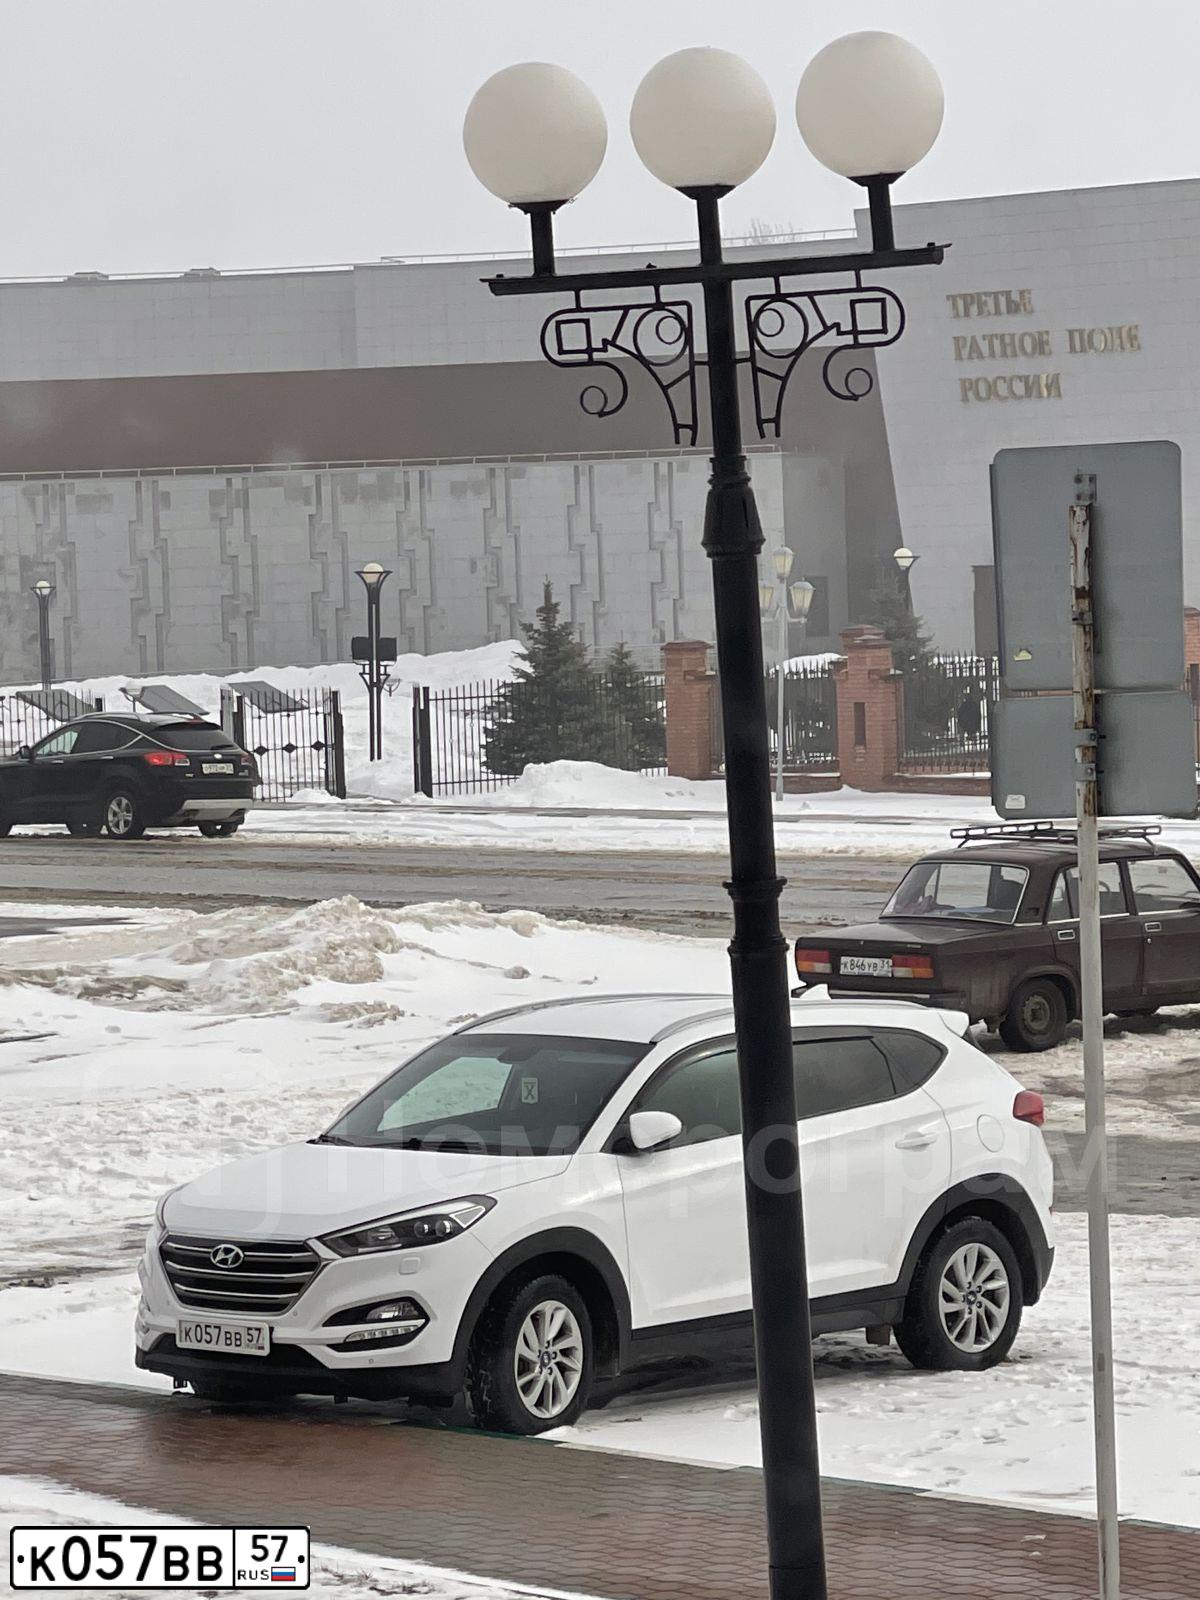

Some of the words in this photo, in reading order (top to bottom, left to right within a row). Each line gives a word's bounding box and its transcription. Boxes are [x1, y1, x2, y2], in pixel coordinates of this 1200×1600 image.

[946, 289, 1034, 319] ТРЕТЬЕ
[953, 330, 1052, 361] РАТНОЕ
[1066, 325, 1142, 354] ПОЛЕ
[959, 373, 1062, 402] РОССИИ
[184, 1324, 242, 1347] К057ВВ
[246, 1328, 262, 1343] 57
